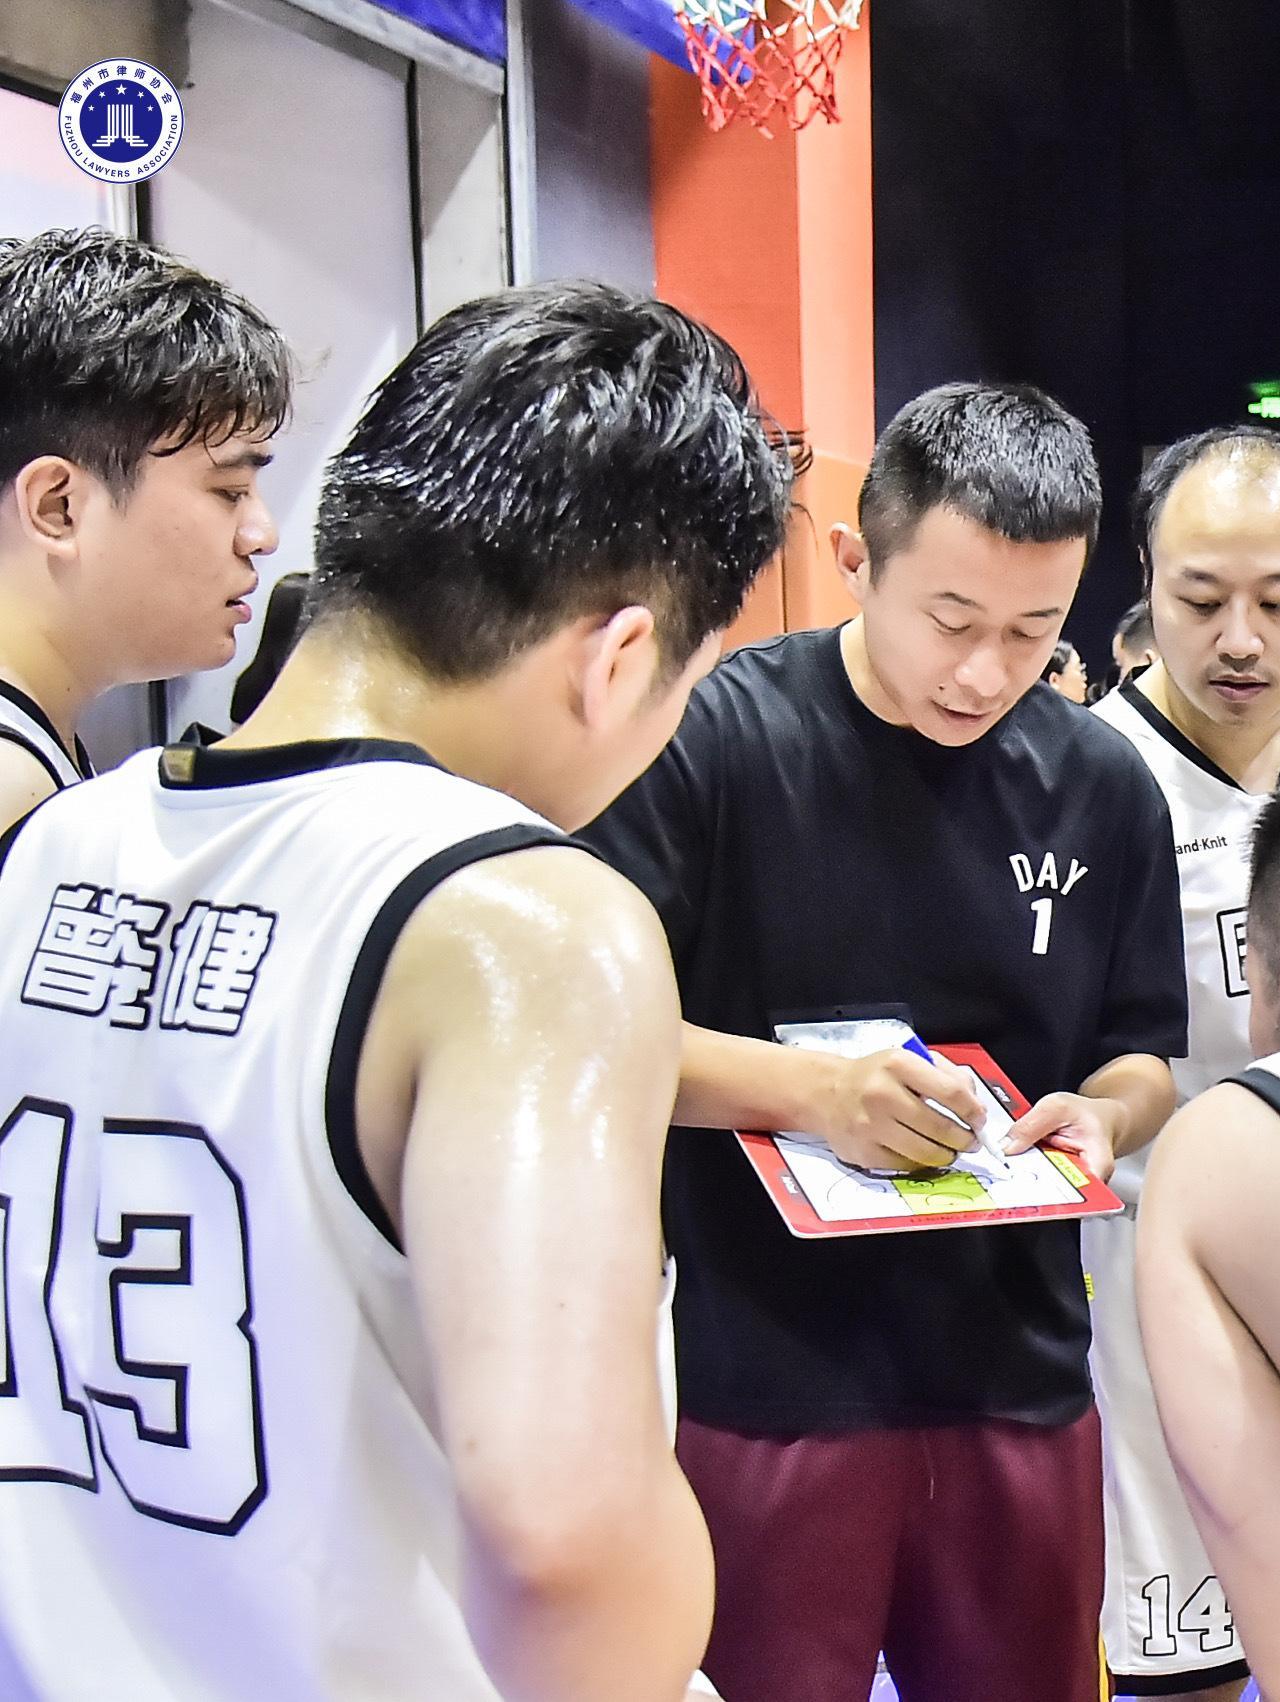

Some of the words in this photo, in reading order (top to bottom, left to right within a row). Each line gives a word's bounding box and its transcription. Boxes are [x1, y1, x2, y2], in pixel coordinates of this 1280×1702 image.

[1009, 852, 1088, 895] DAY
[1031, 898, 1052, 955] 1
[0, 1096, 268, 1536] 13
[1141, 1574, 1233, 1656] 14
